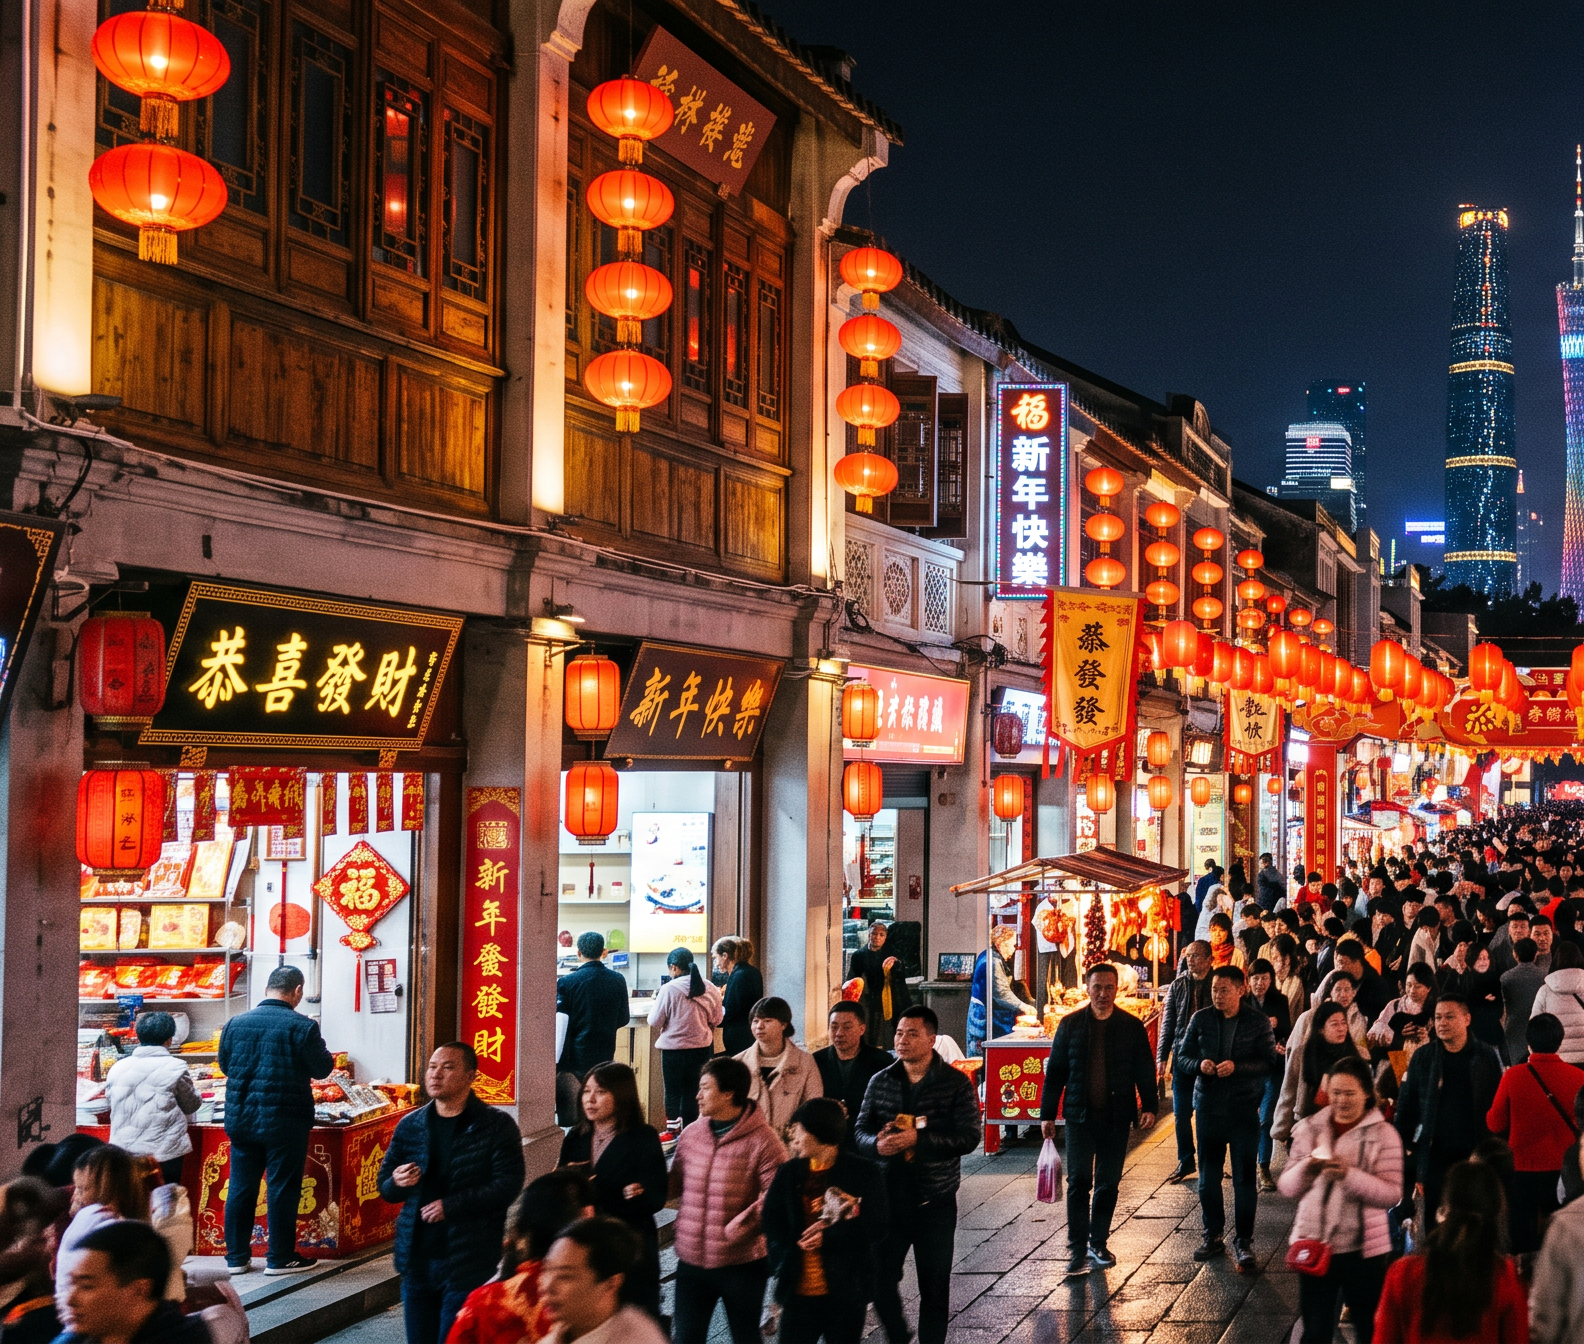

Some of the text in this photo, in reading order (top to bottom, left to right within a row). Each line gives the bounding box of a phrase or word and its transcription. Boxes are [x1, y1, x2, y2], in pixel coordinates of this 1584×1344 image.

[1011, 436, 1050, 588] 新年快樂
[188, 626, 417, 718] 恭喜發財
[629, 666, 764, 741] 新年快樂
[339, 868, 381, 911] 福
